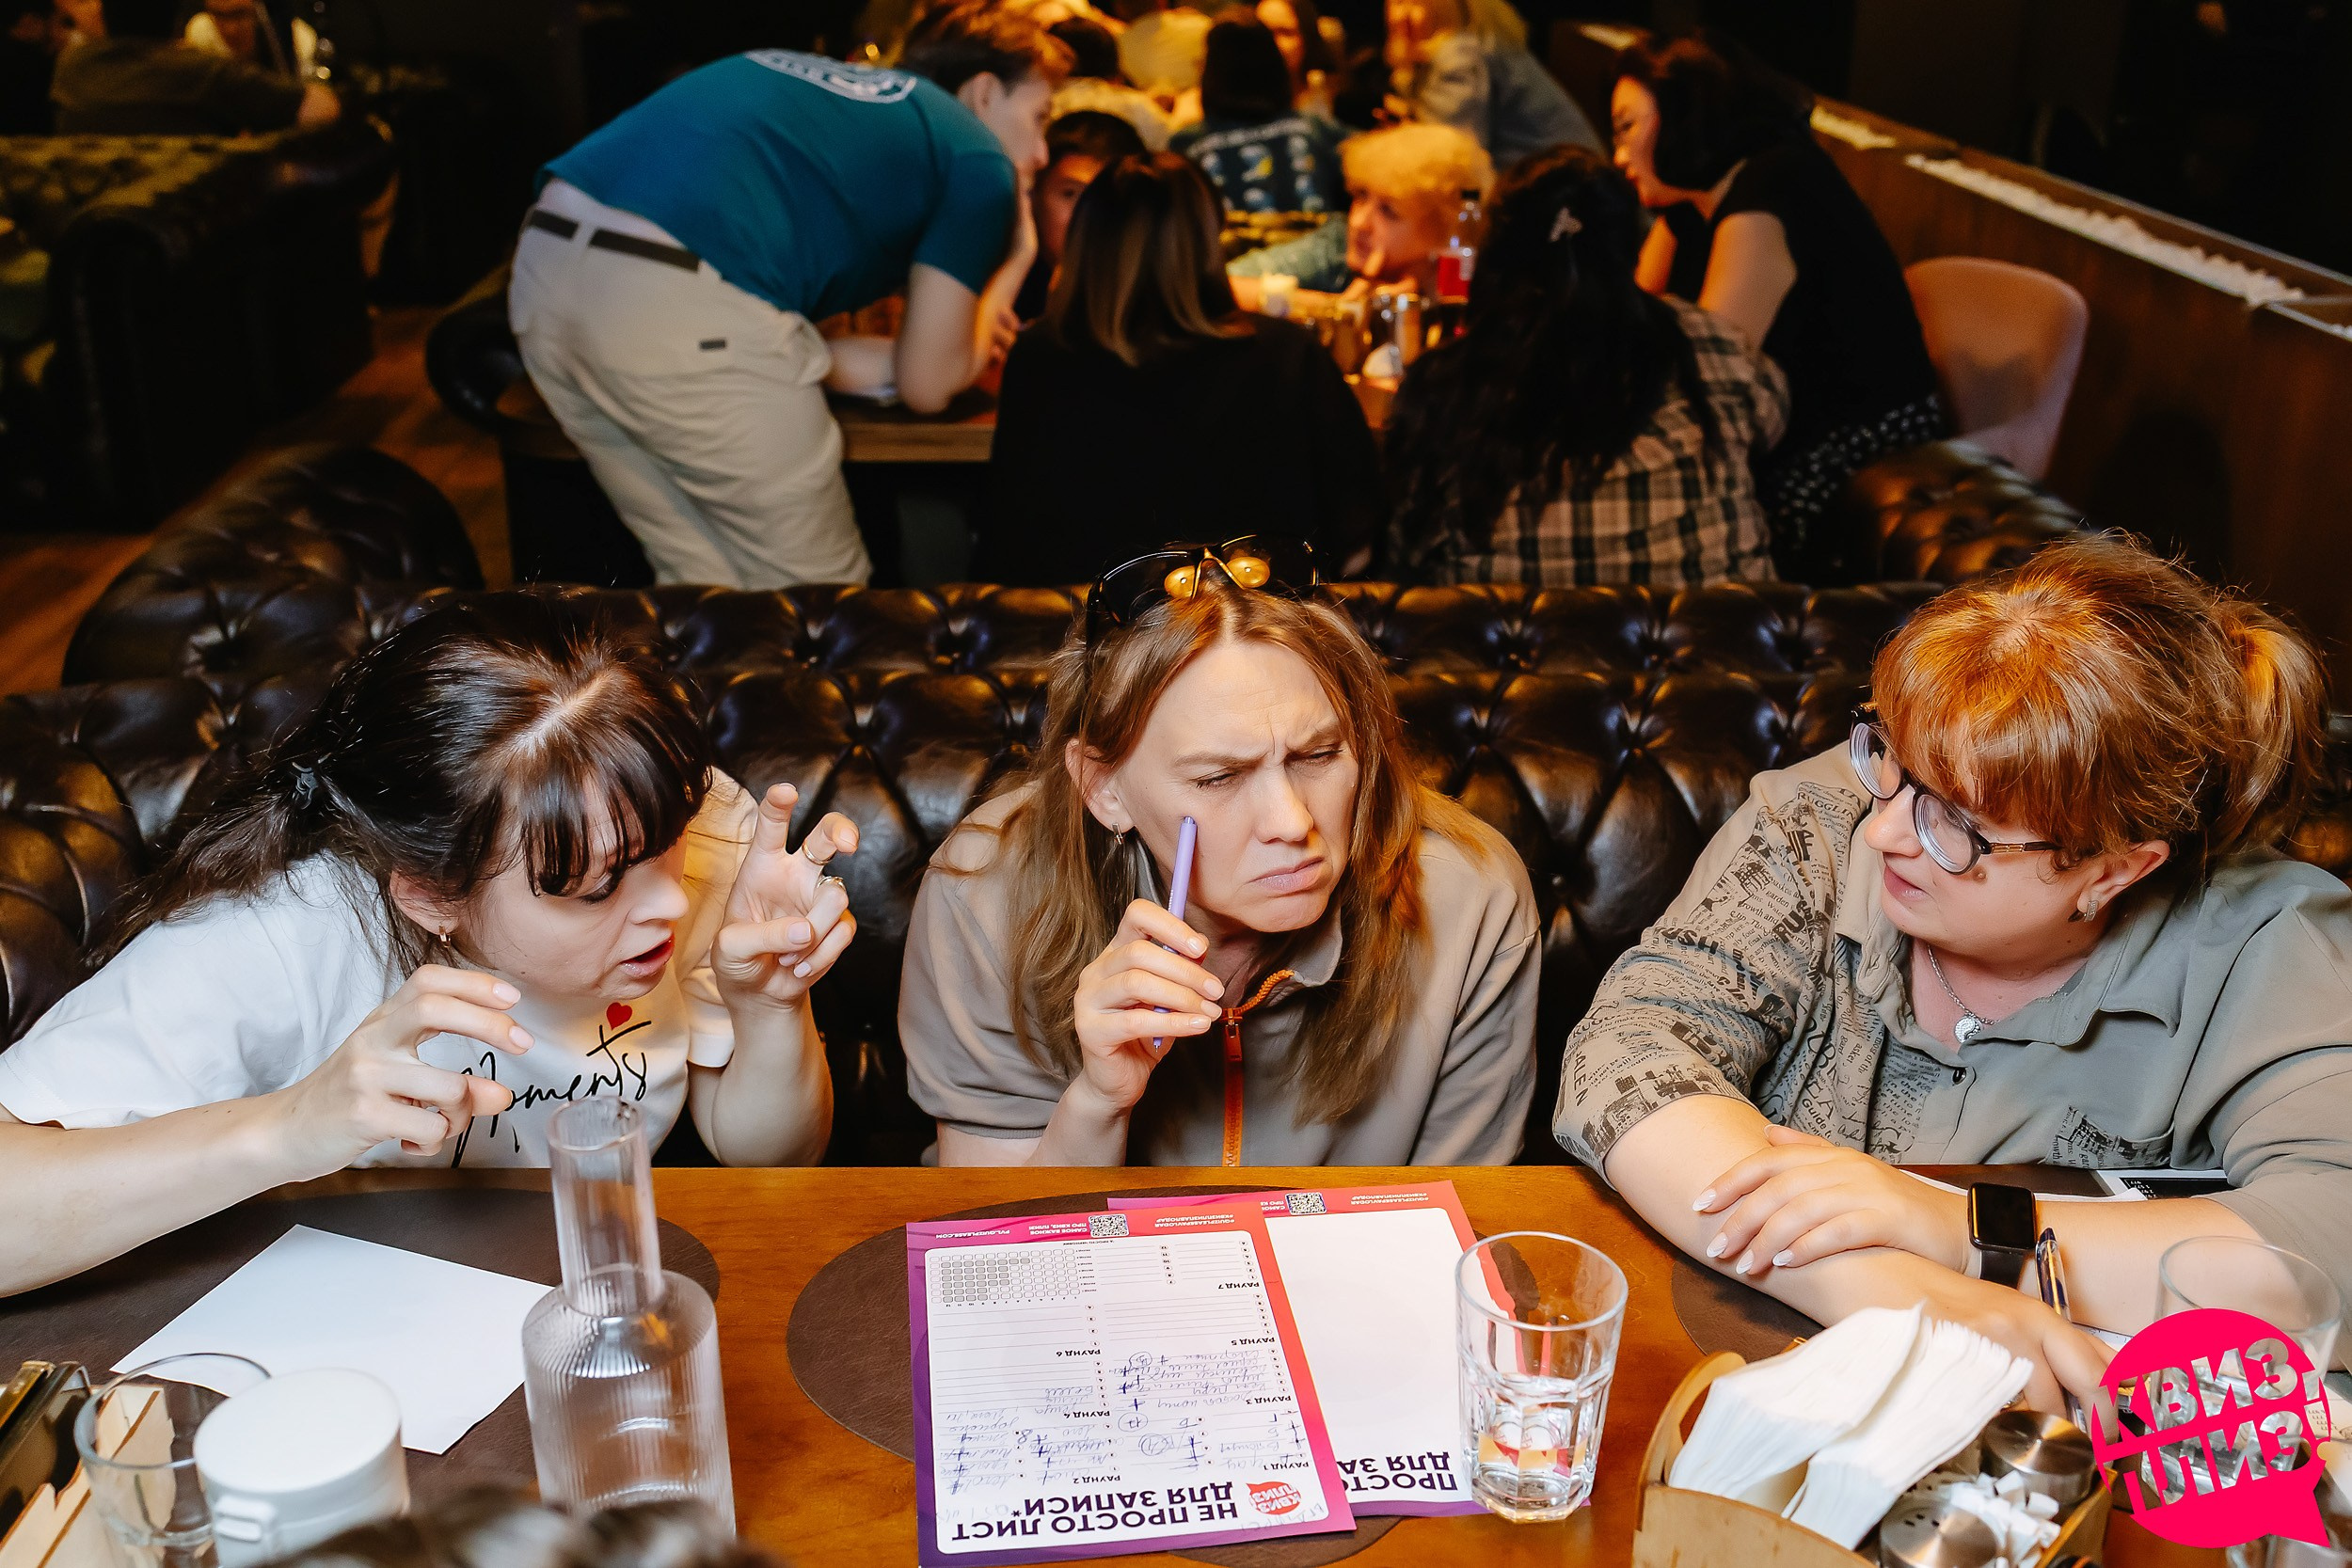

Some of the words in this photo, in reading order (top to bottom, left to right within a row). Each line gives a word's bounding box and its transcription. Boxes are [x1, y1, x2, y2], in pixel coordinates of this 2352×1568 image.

[1802, 1098, 1828, 1130] Guide
[1239, 1337, 1275, 1345] РАУНД
[1254, 1395, 1292, 1404] РАУНД
[1270, 1461, 1310, 1470] РАУНД
[1336, 1458, 1378, 1474] ЗА
[1386, 1451, 1450, 1471] ДЛЯ
[1082, 1475, 1120, 1483] РАУНД
[1167, 1481, 1233, 1504] ДЛЯ
[1051, 1506, 1189, 1533] ПРОСТО
[1198, 1502, 1238, 1522] НЕ
[952, 1518, 1041, 1540] ЛИСТ
